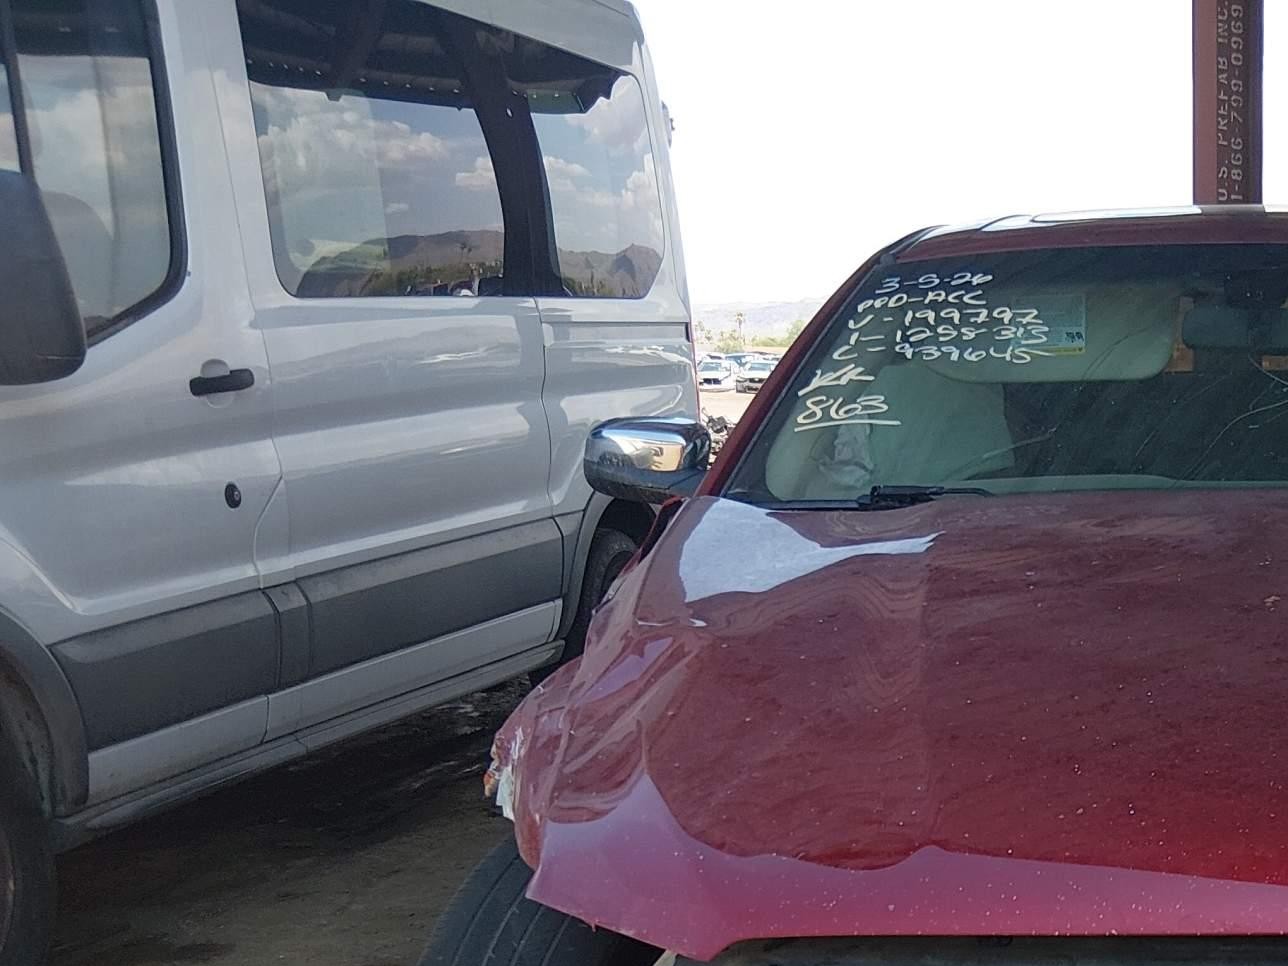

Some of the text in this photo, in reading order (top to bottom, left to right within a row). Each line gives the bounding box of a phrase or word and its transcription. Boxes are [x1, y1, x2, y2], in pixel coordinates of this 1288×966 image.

[1217, 0, 1229, 202] U.S. PREFAB INC.
[1230, 4, 1243, 202] 1-866-799-0969
[796, 394, 890, 424] 863
